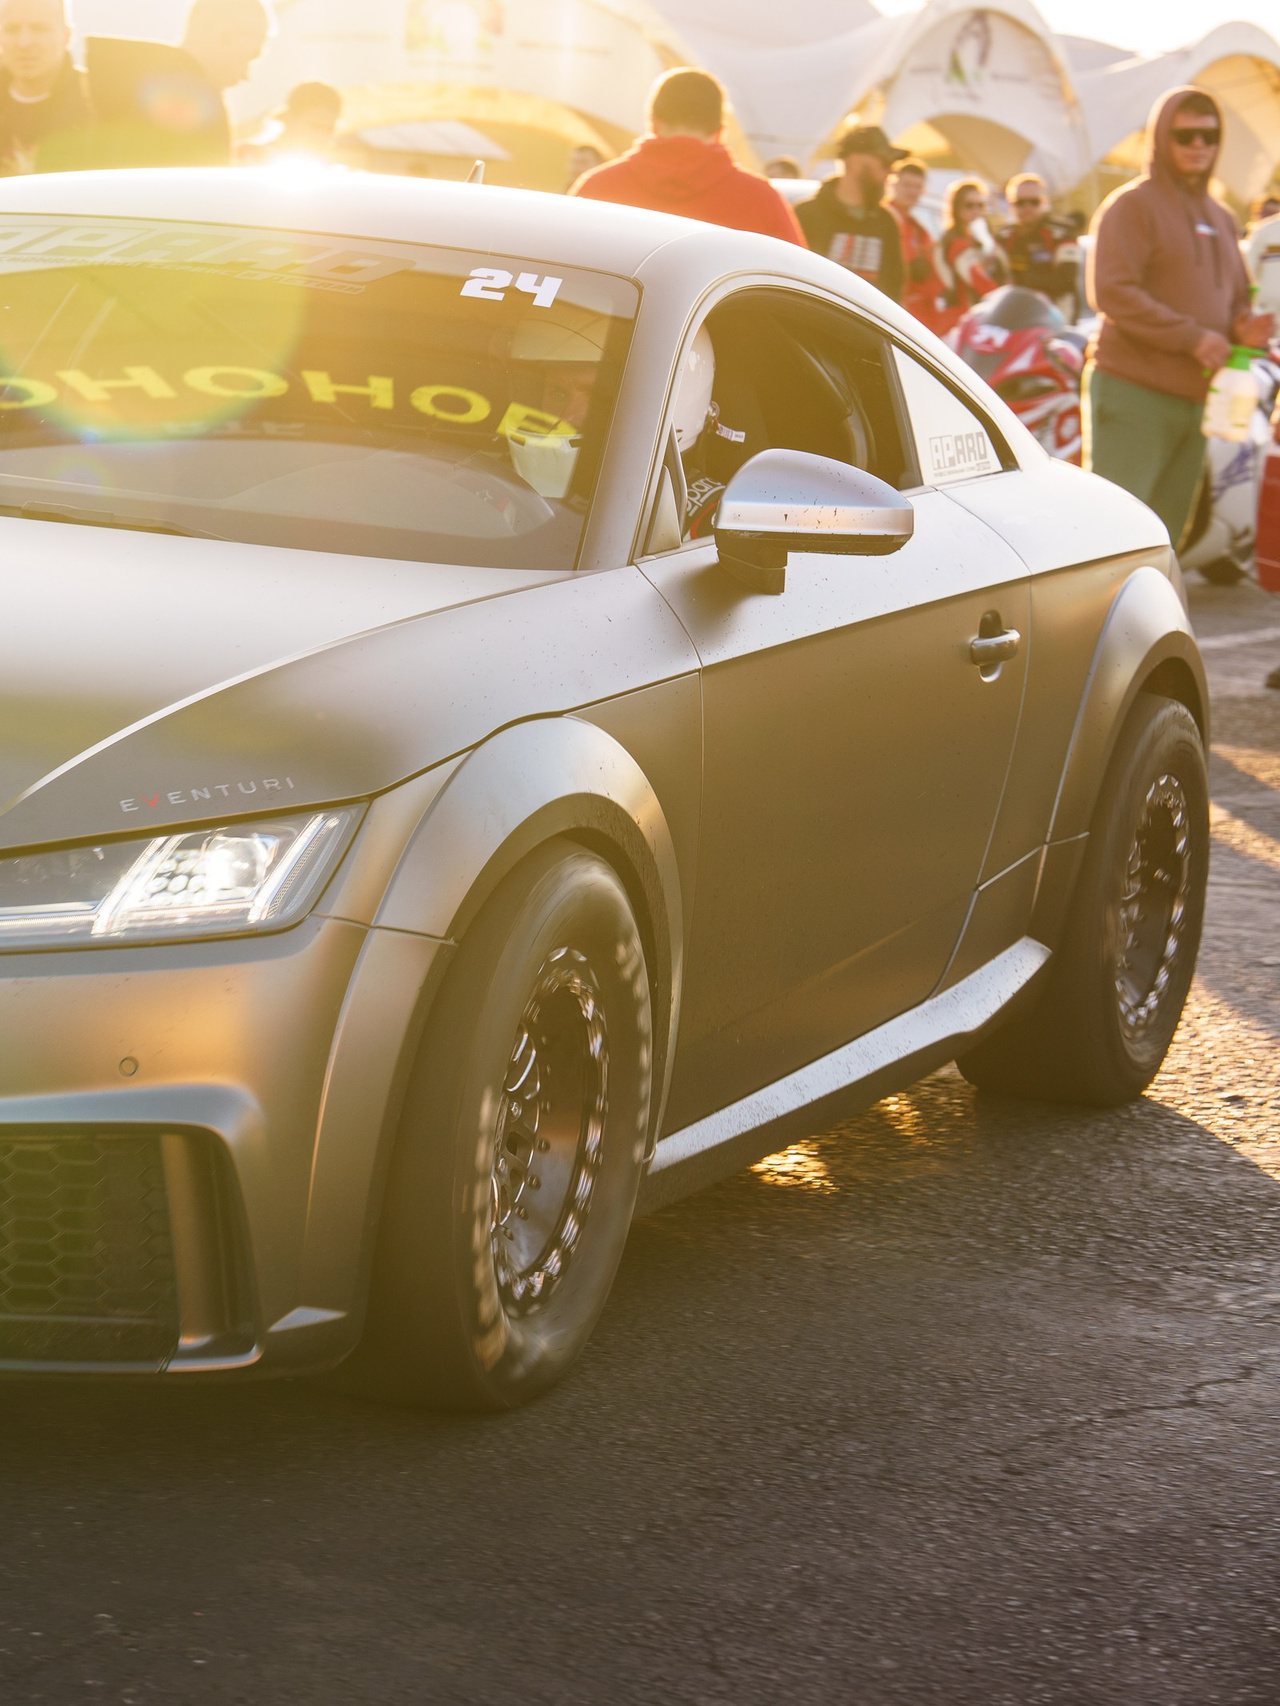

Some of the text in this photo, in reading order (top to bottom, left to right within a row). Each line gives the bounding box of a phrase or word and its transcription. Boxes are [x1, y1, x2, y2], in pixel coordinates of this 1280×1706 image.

[460, 267, 563, 308] 24
[929, 431, 988, 470] APARD
[119, 776, 295, 812] EVENTURI
